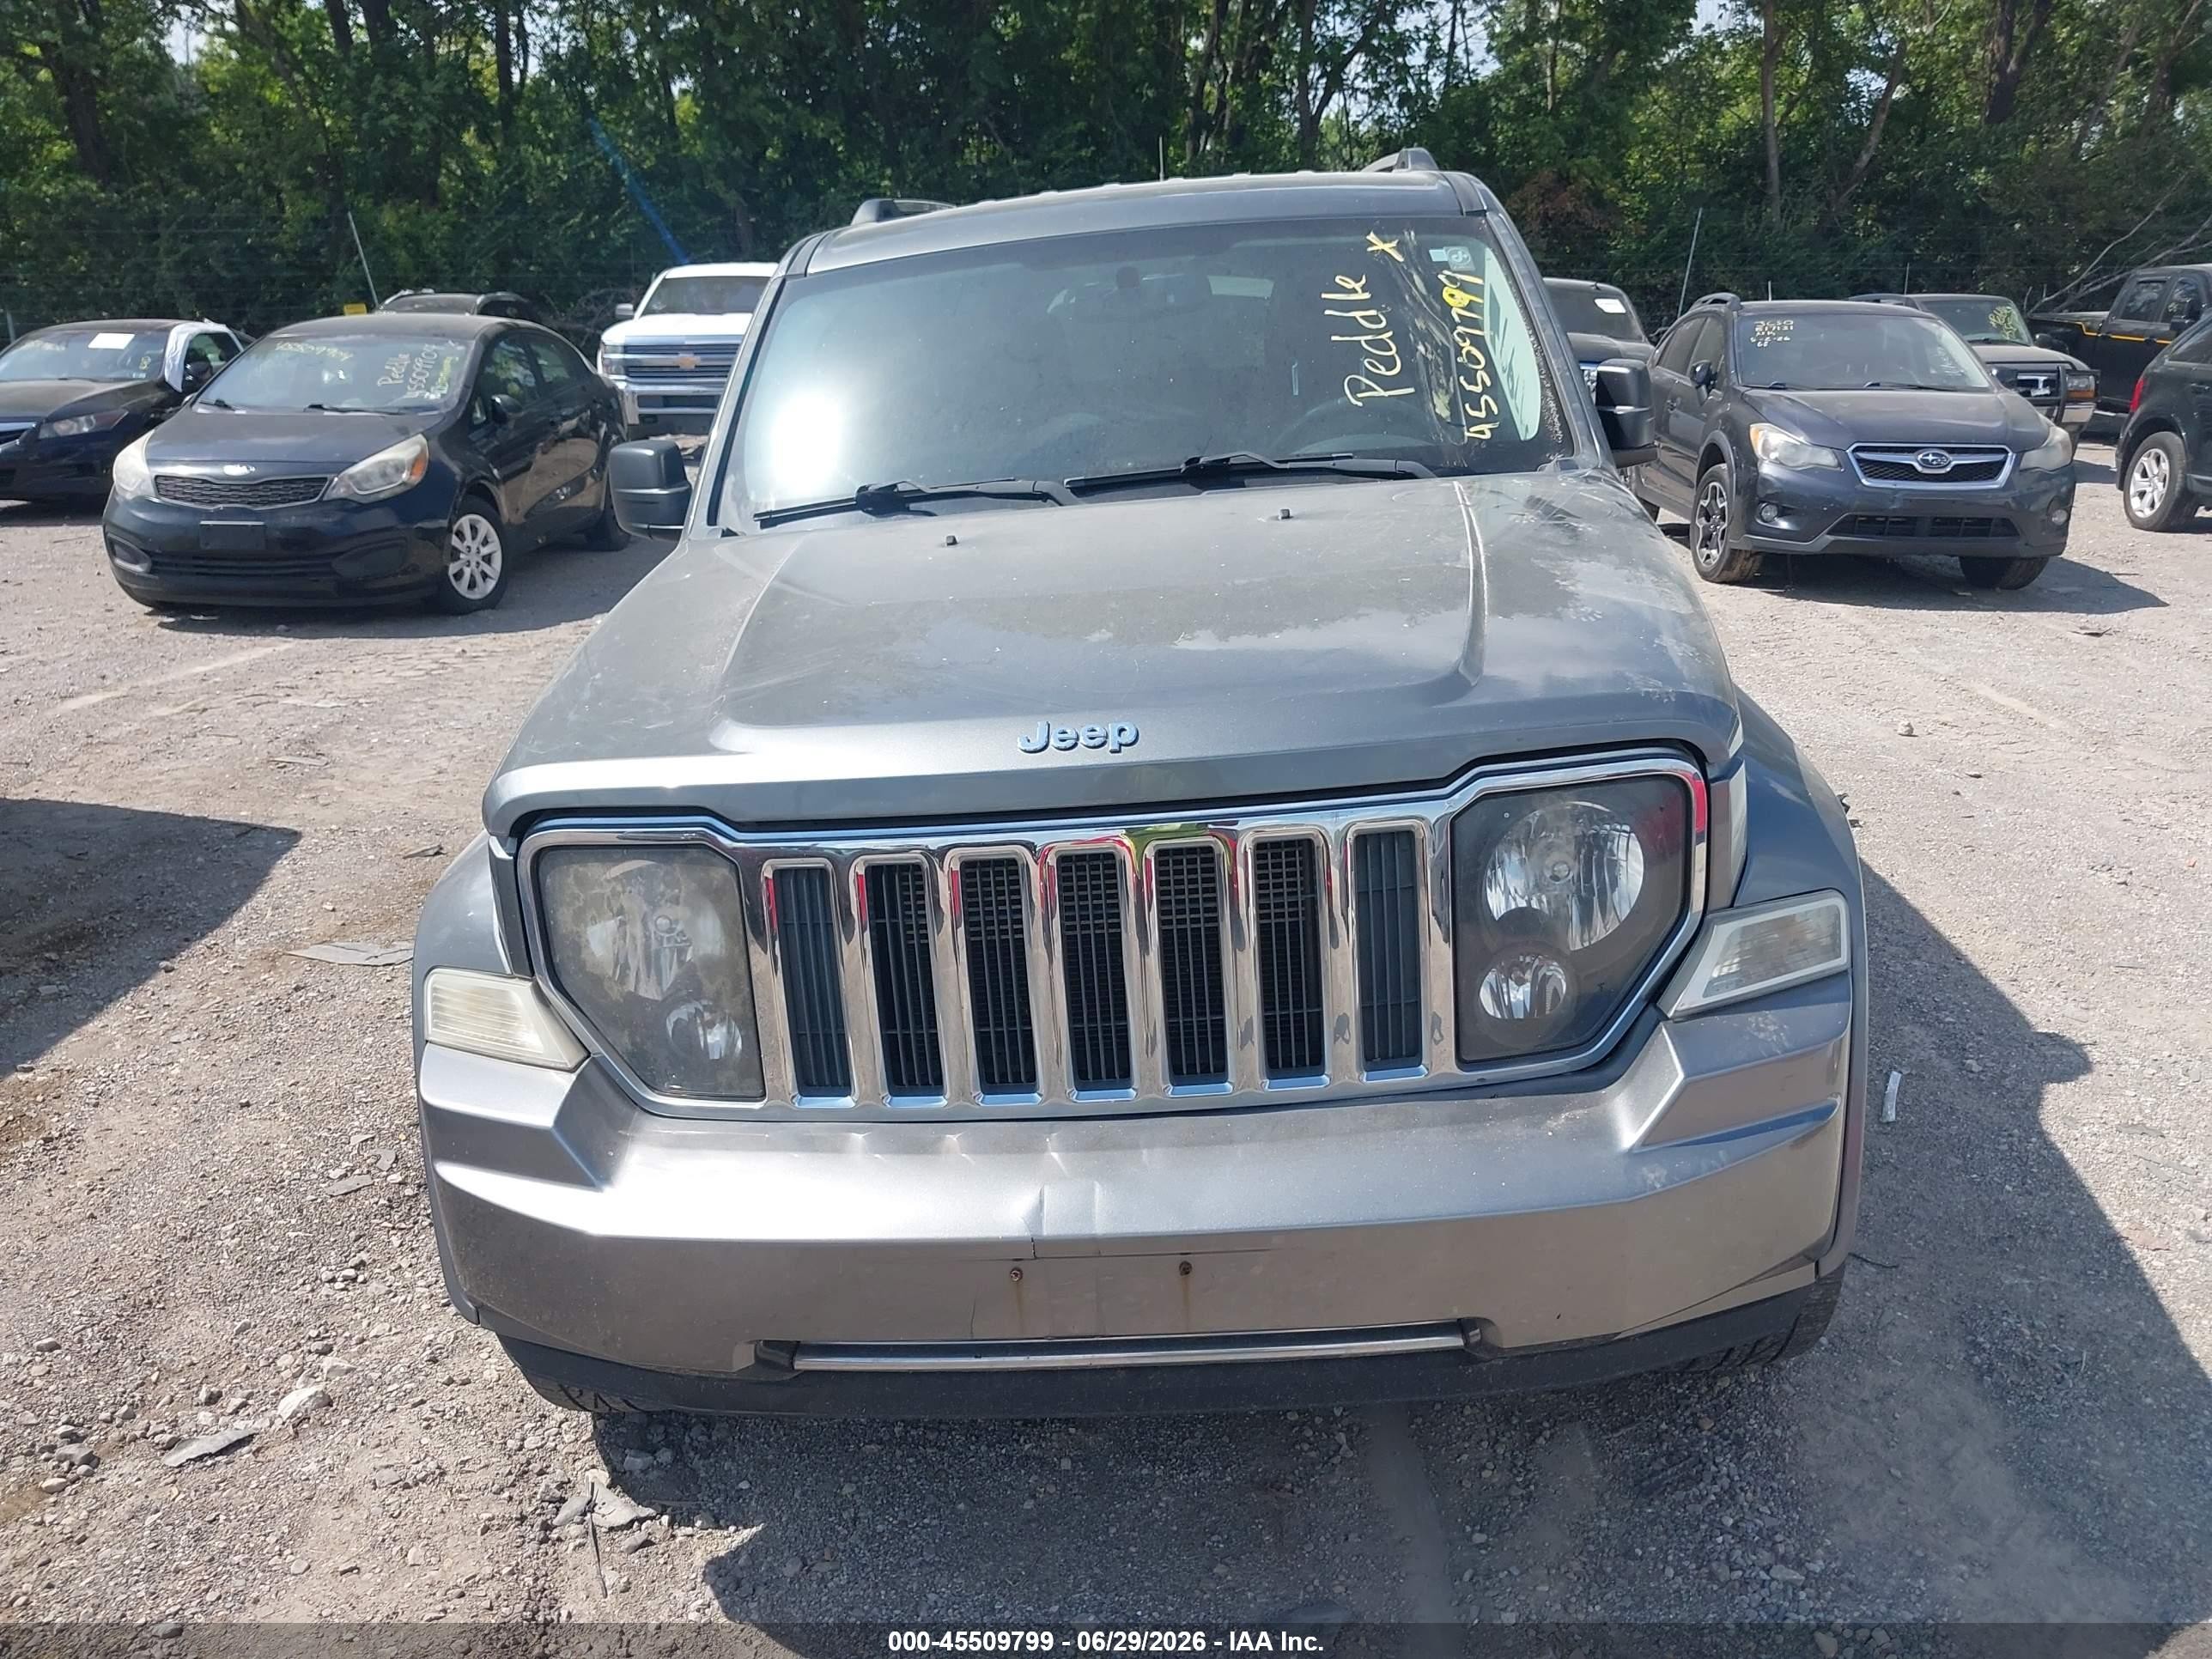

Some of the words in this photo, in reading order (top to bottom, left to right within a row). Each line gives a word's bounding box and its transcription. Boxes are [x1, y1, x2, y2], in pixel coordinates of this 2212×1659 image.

[1321, 274, 1415, 407] Peddle
[1437, 269, 1500, 441] 45509799
[1018, 720, 1139, 754] Jeep
